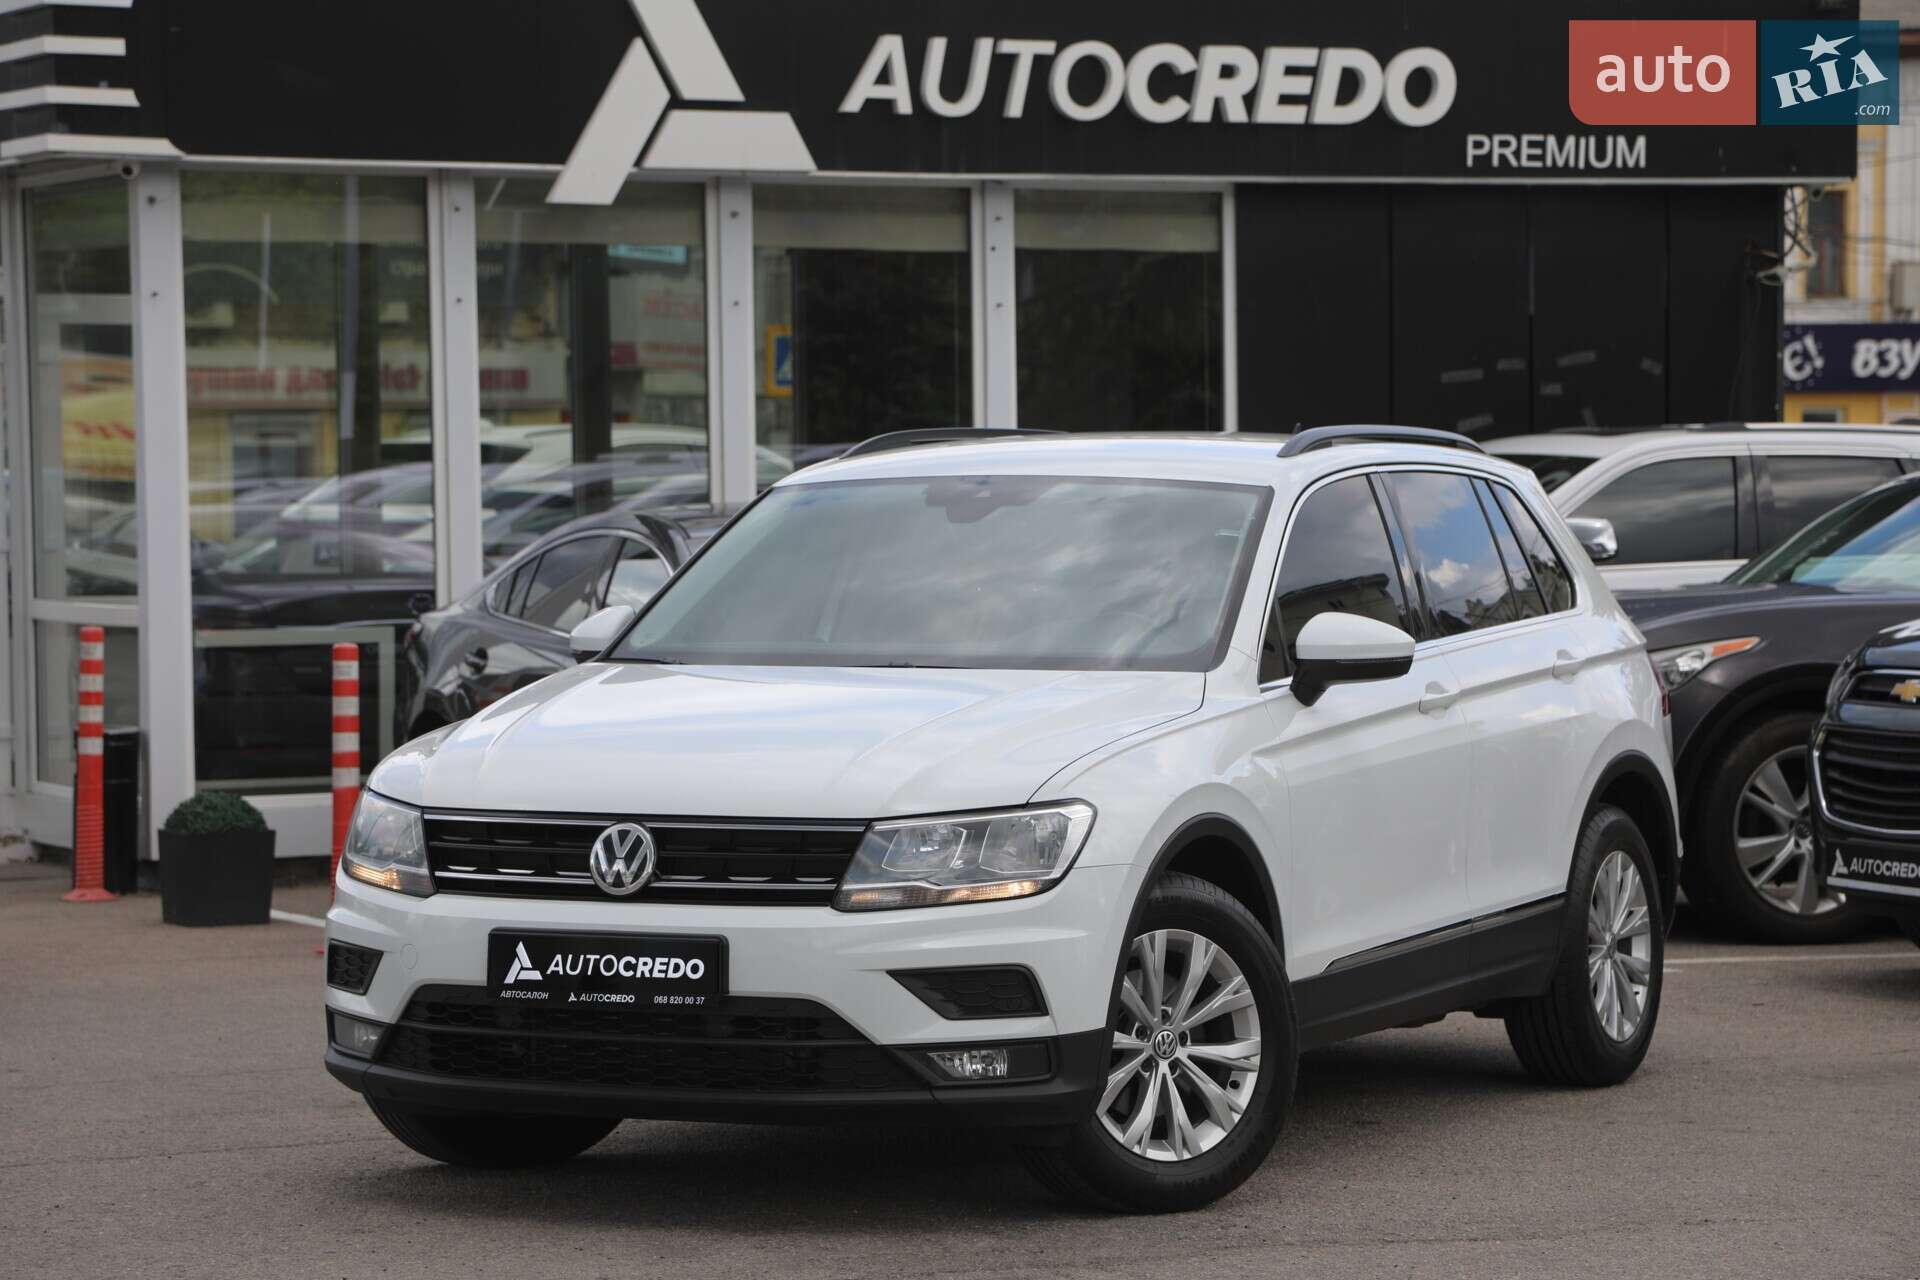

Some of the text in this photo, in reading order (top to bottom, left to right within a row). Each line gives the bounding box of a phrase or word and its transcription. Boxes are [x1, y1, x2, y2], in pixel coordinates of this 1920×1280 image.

[838, 33, 1458, 127] AUTOCREDO
[1466, 133, 1647, 170] PREMIUM
[1849, 857, 1920, 879] AUTOCRED
[546, 954, 705, 980] AUTOCREDO
[500, 990, 549, 1000] АВТОСАЛОН
[579, 993, 635, 1003] AUTOCREDO
[654, 995, 705, 1005] 068 820 00 37
